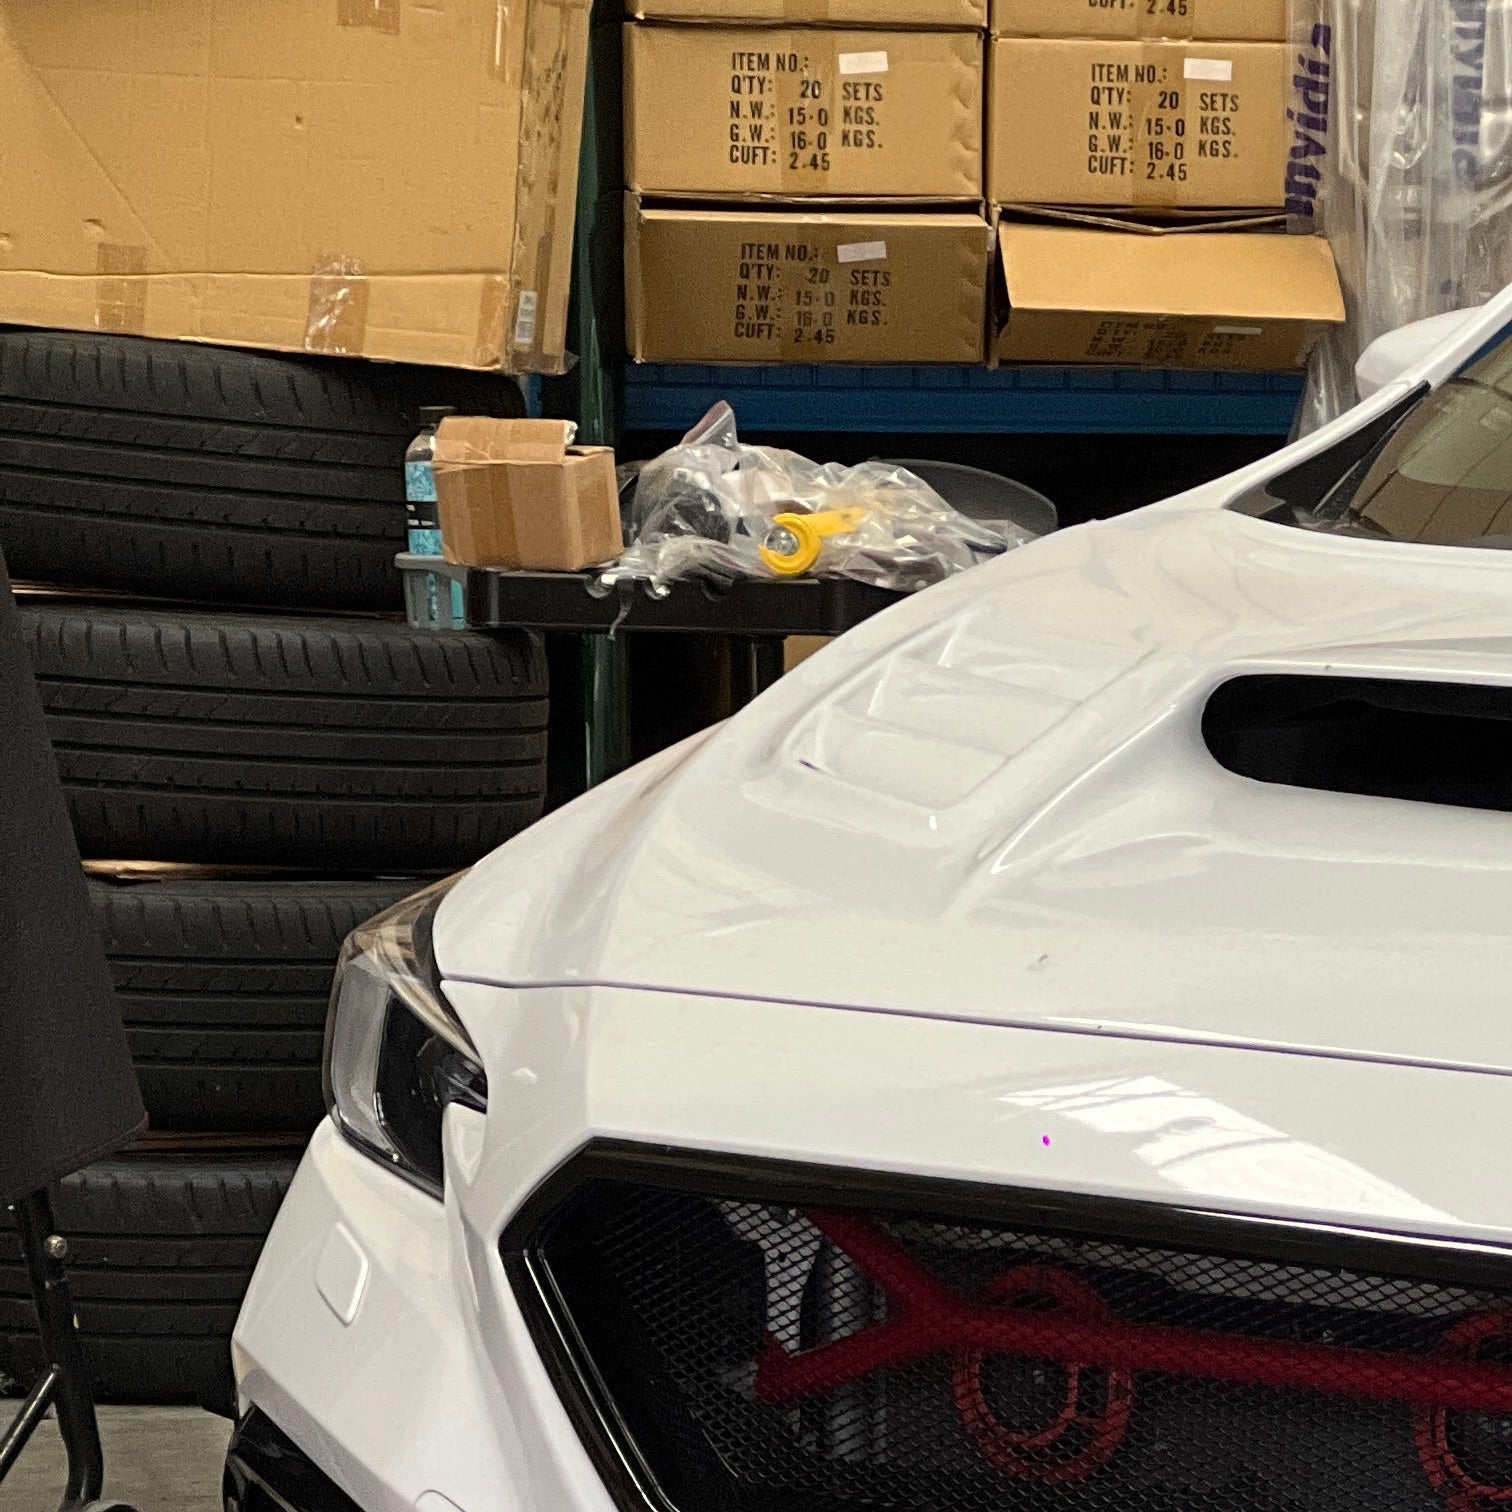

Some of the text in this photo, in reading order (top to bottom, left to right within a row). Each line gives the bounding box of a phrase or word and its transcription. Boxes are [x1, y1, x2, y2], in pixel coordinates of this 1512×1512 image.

[732, 52, 770, 72] ITEM
[1091, 63, 1129, 82] ITEM
[731, 75, 883, 101] Q'TY: 20 SETS
[1091, 86, 1239, 112] Q'TY: 20 SETS
[730, 100, 775, 120] N.W.:
[843, 105, 880, 126] KGS.
[1089, 111, 1133, 130] N.W.:
[1200, 117, 1236, 136] KGS.
[729, 124, 775, 143] G.W.:
[841, 129, 882, 149] KGS.
[1088, 135, 1133, 153] G.W.:
[1199, 140, 1239, 158] KGS.
[729, 145, 830, 171] CUFT: 2.45
[1088, 155, 1187, 181] CUFT: 2.45
[808, 267, 830, 284] 20
[850, 269, 891, 287] SETS
[794, 328, 835, 344] 2.45
